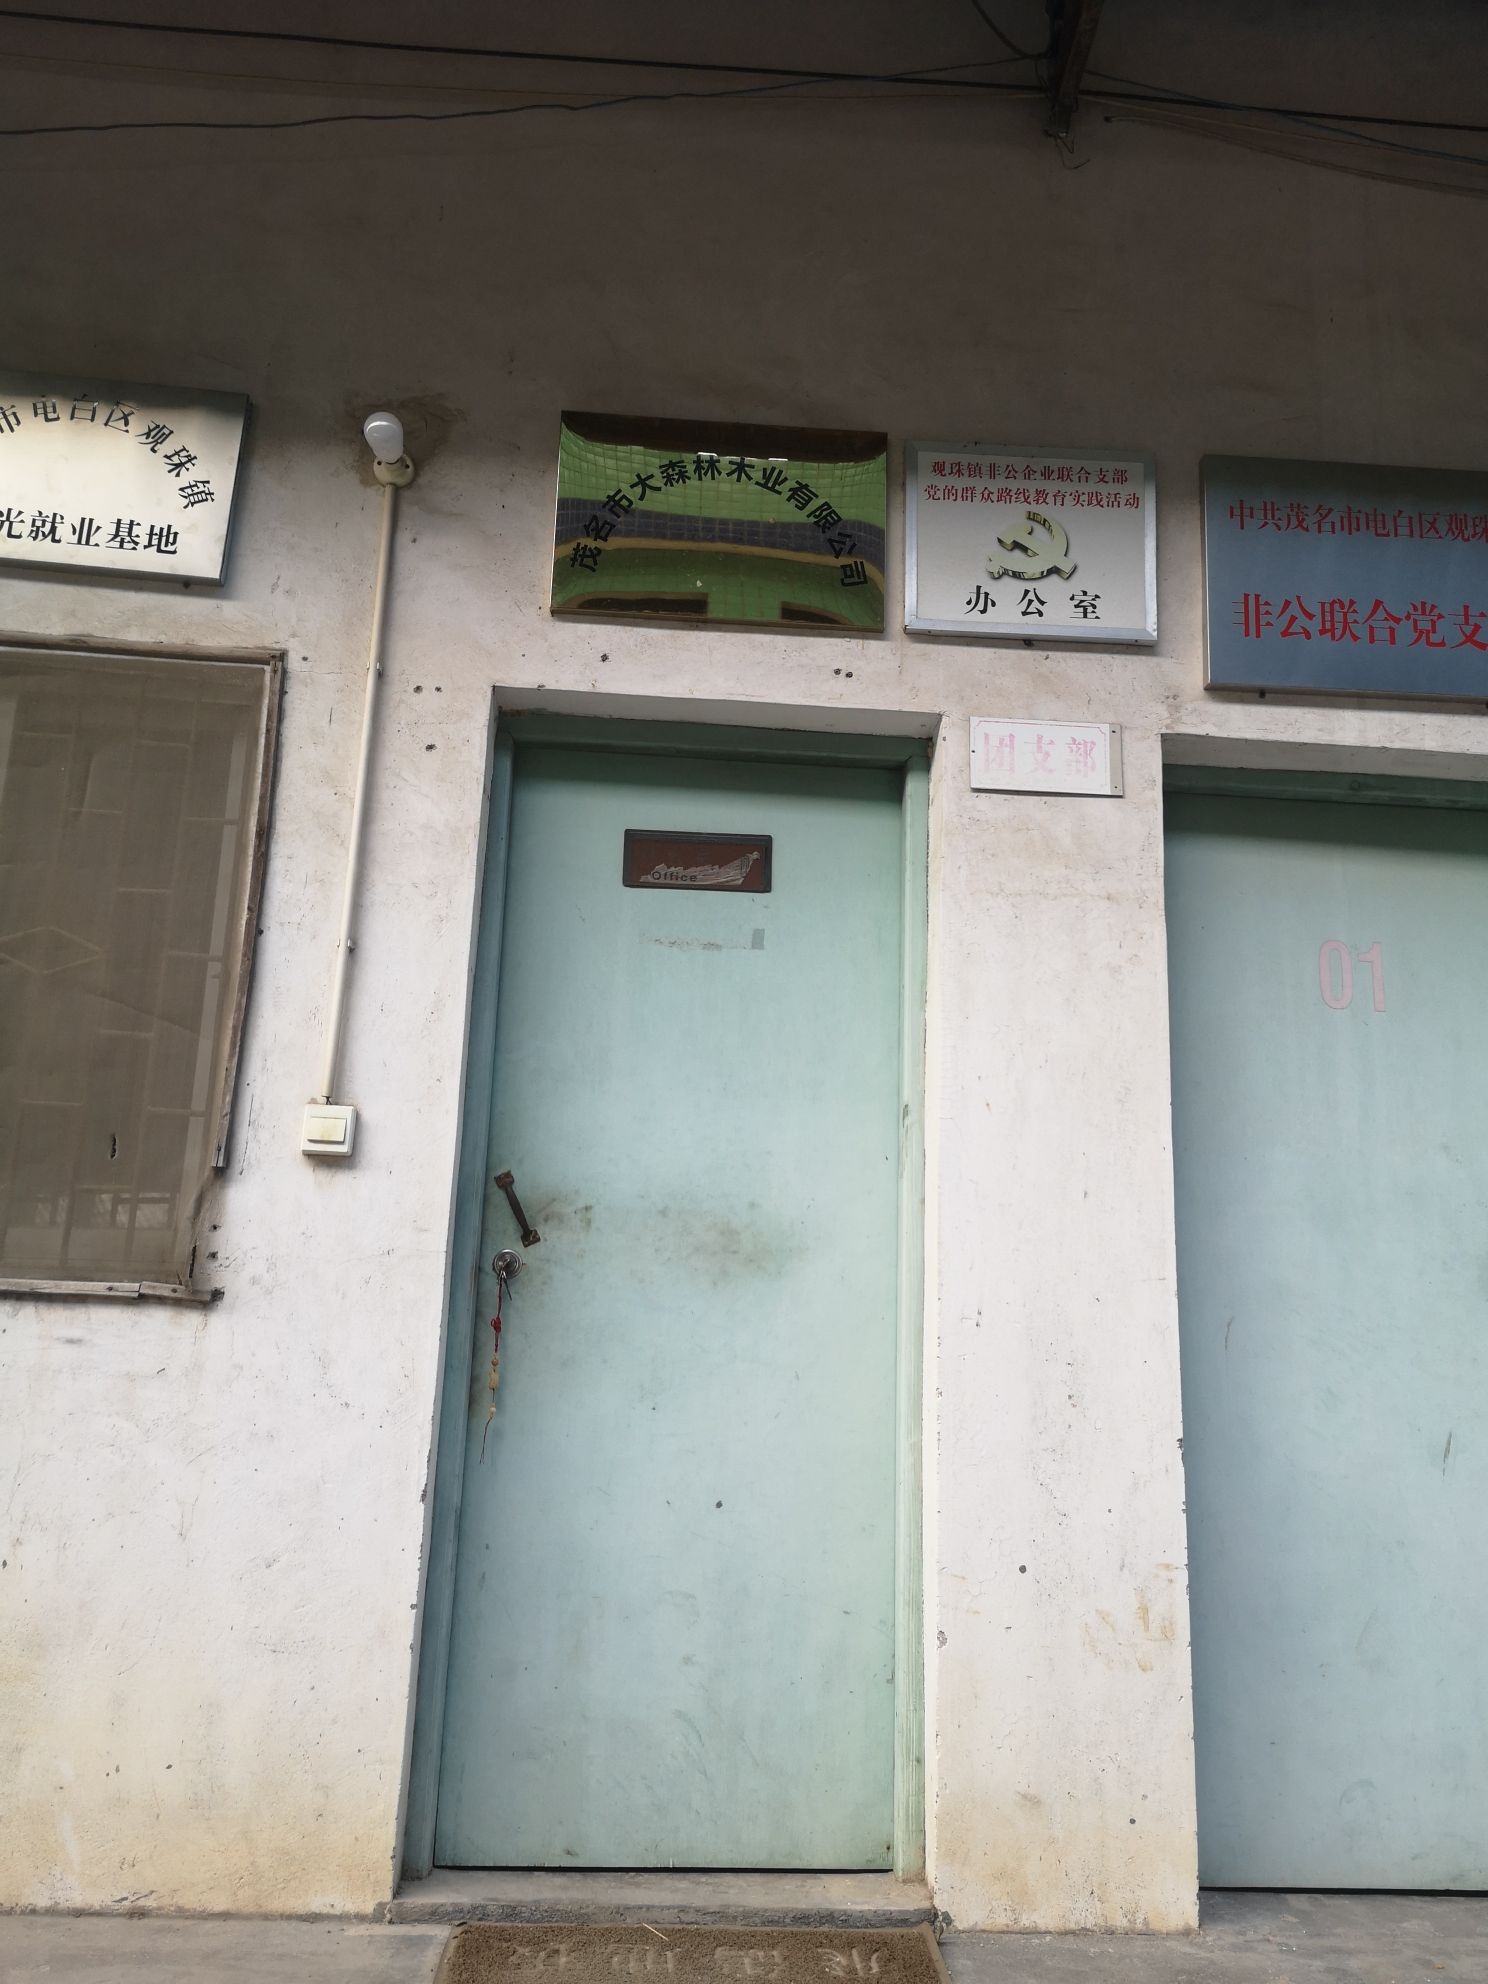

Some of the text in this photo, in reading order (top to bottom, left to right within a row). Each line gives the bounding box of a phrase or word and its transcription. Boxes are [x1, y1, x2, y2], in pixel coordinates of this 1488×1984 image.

[0, 394, 215, 509] 市电白区观珠镇
[931, 461, 1129, 486] 观珠镇非公企业联合支部
[569, 454, 869, 588] 茂名市大森林木业有限公司
[924, 485, 1140, 509] 党的群众路线教育实践活动
[0, 507, 180, 555] 光就业基地
[964, 584, 1102, 621] 办公室
[1231, 592, 1488, 651] 非公联合党支
[651, 870, 698, 883] Office
[1318, 939, 1387, 1013] 01
